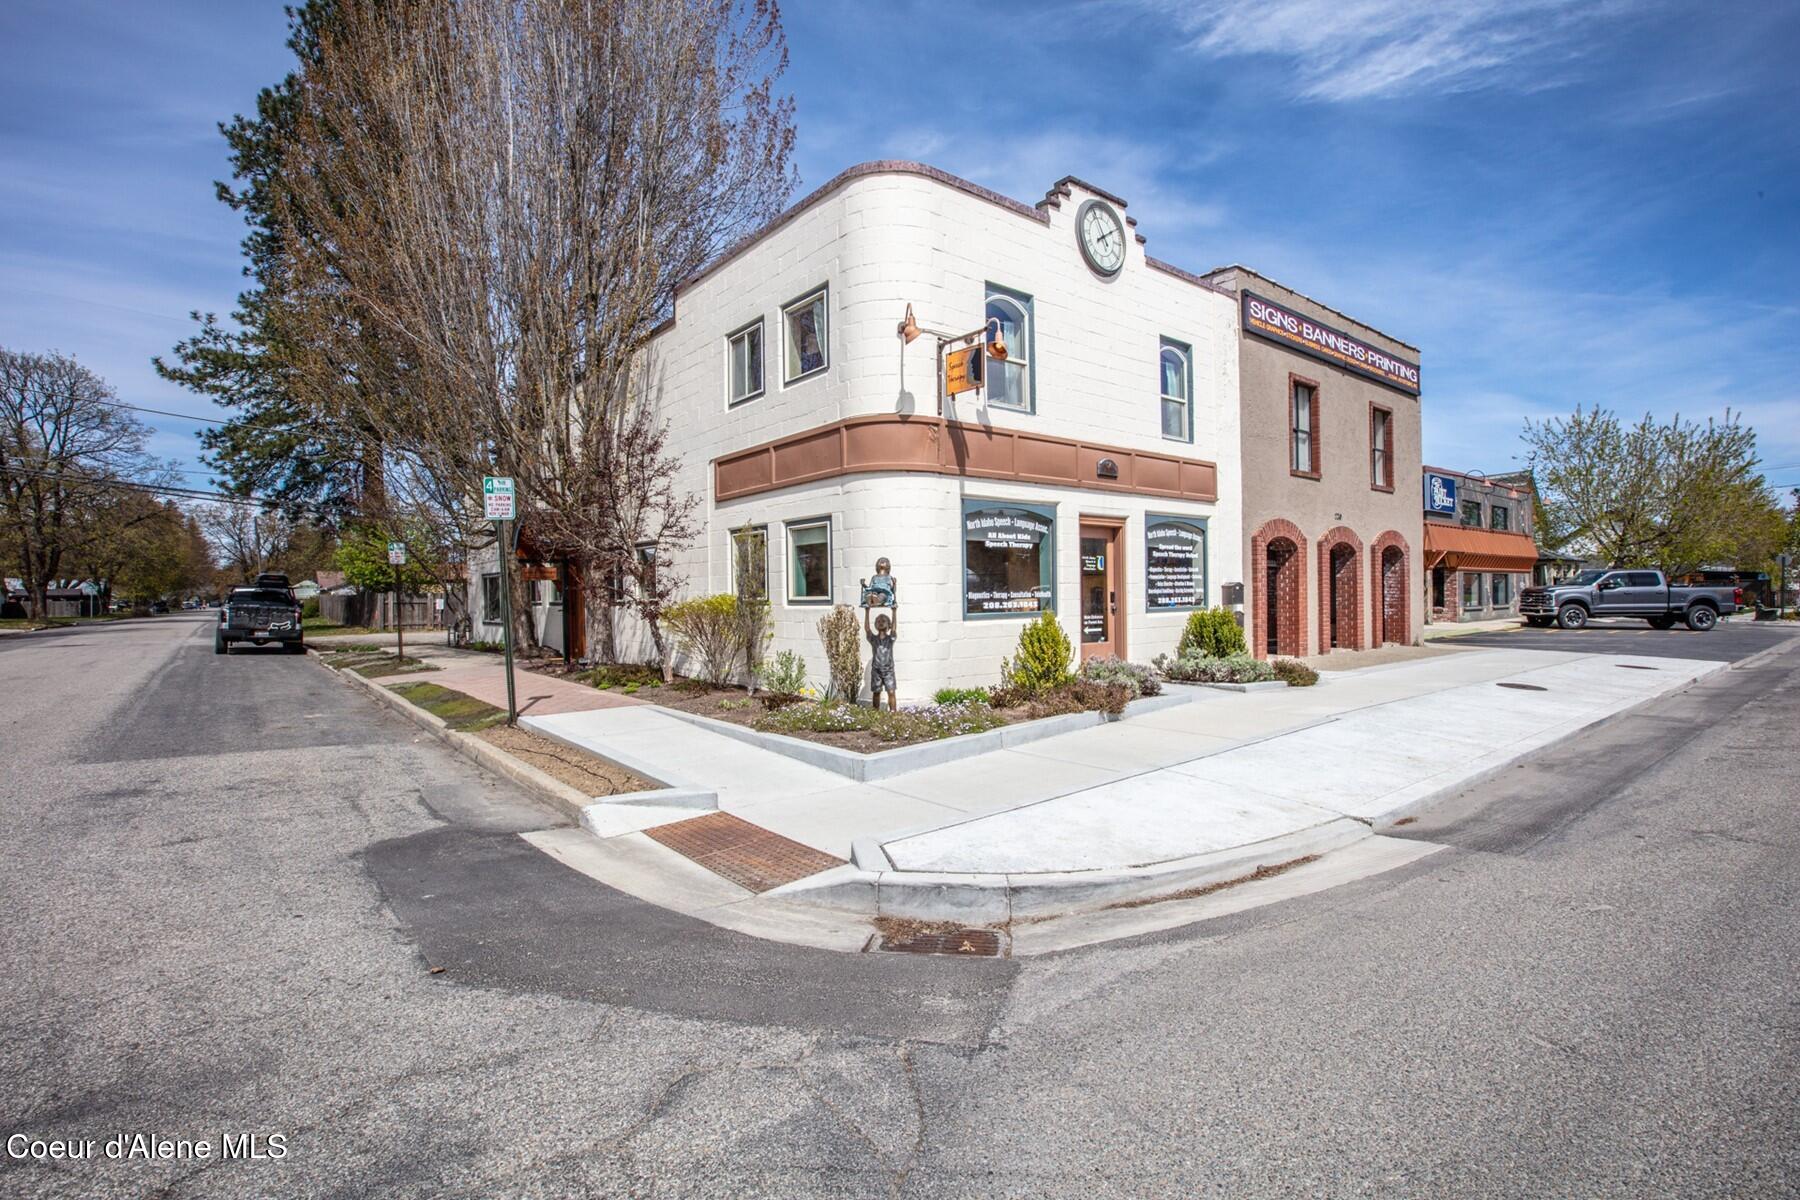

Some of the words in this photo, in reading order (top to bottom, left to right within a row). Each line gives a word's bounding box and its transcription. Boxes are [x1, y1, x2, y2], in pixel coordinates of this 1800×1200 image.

[1250, 301, 1298, 333] SIGNS
[1302, 322, 1366, 361] BANNERS
[1367, 350, 1418, 383] PRINTING
[486, 480, 492, 491] 4
[966, 518, 980, 530] North
[994, 516, 1011, 528] Speech
[1014, 517, 1035, 531] Language
[987, 531, 997, 539] All
[997, 532, 1017, 540] About
[985, 540, 1008, 548] Speech
[1008, 541, 1034, 550] Therapy
[992, 591, 1008, 600] Therapy
